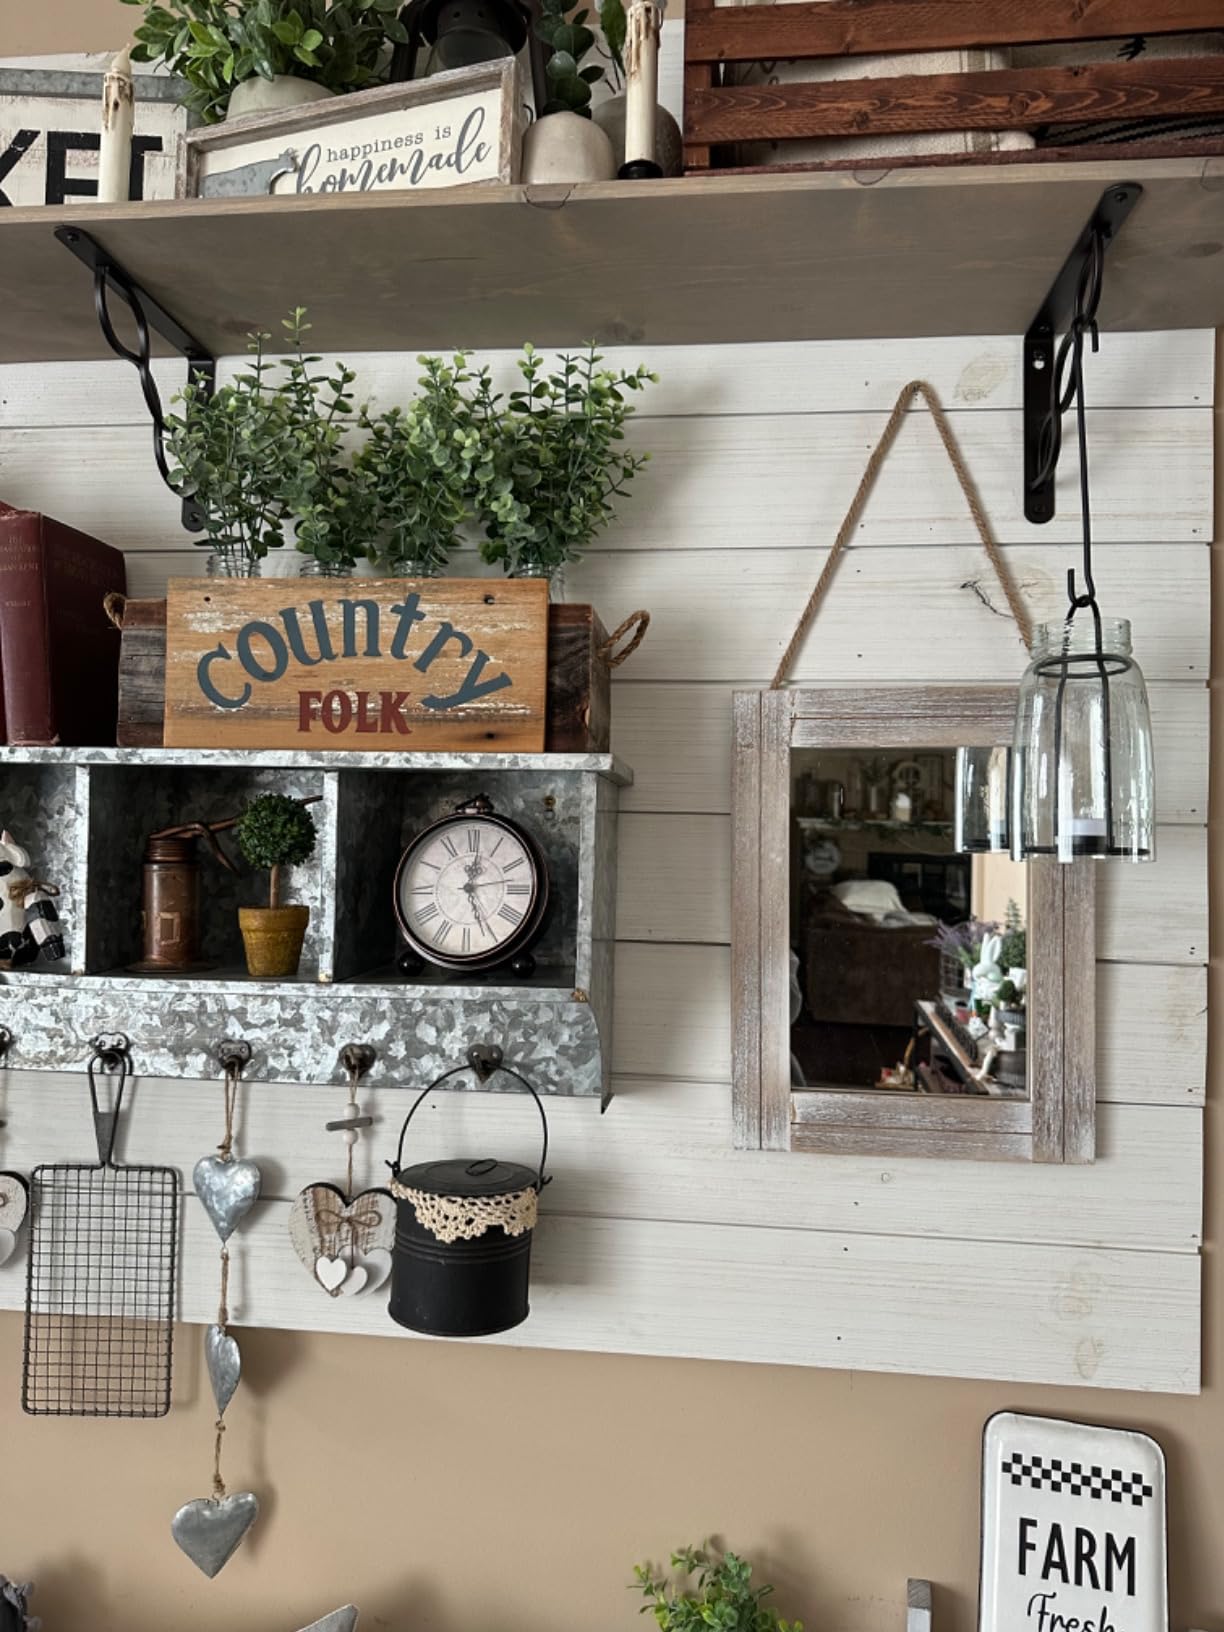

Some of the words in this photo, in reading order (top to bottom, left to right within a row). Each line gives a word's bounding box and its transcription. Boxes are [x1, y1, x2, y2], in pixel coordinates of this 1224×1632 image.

[297, 106, 492, 195] homemade
[326, 131, 424, 163] happiness
[435, 125, 452, 141] is
[297, 690, 413, 735] FOLK
[1018, 1517, 1136, 1596] FARM
